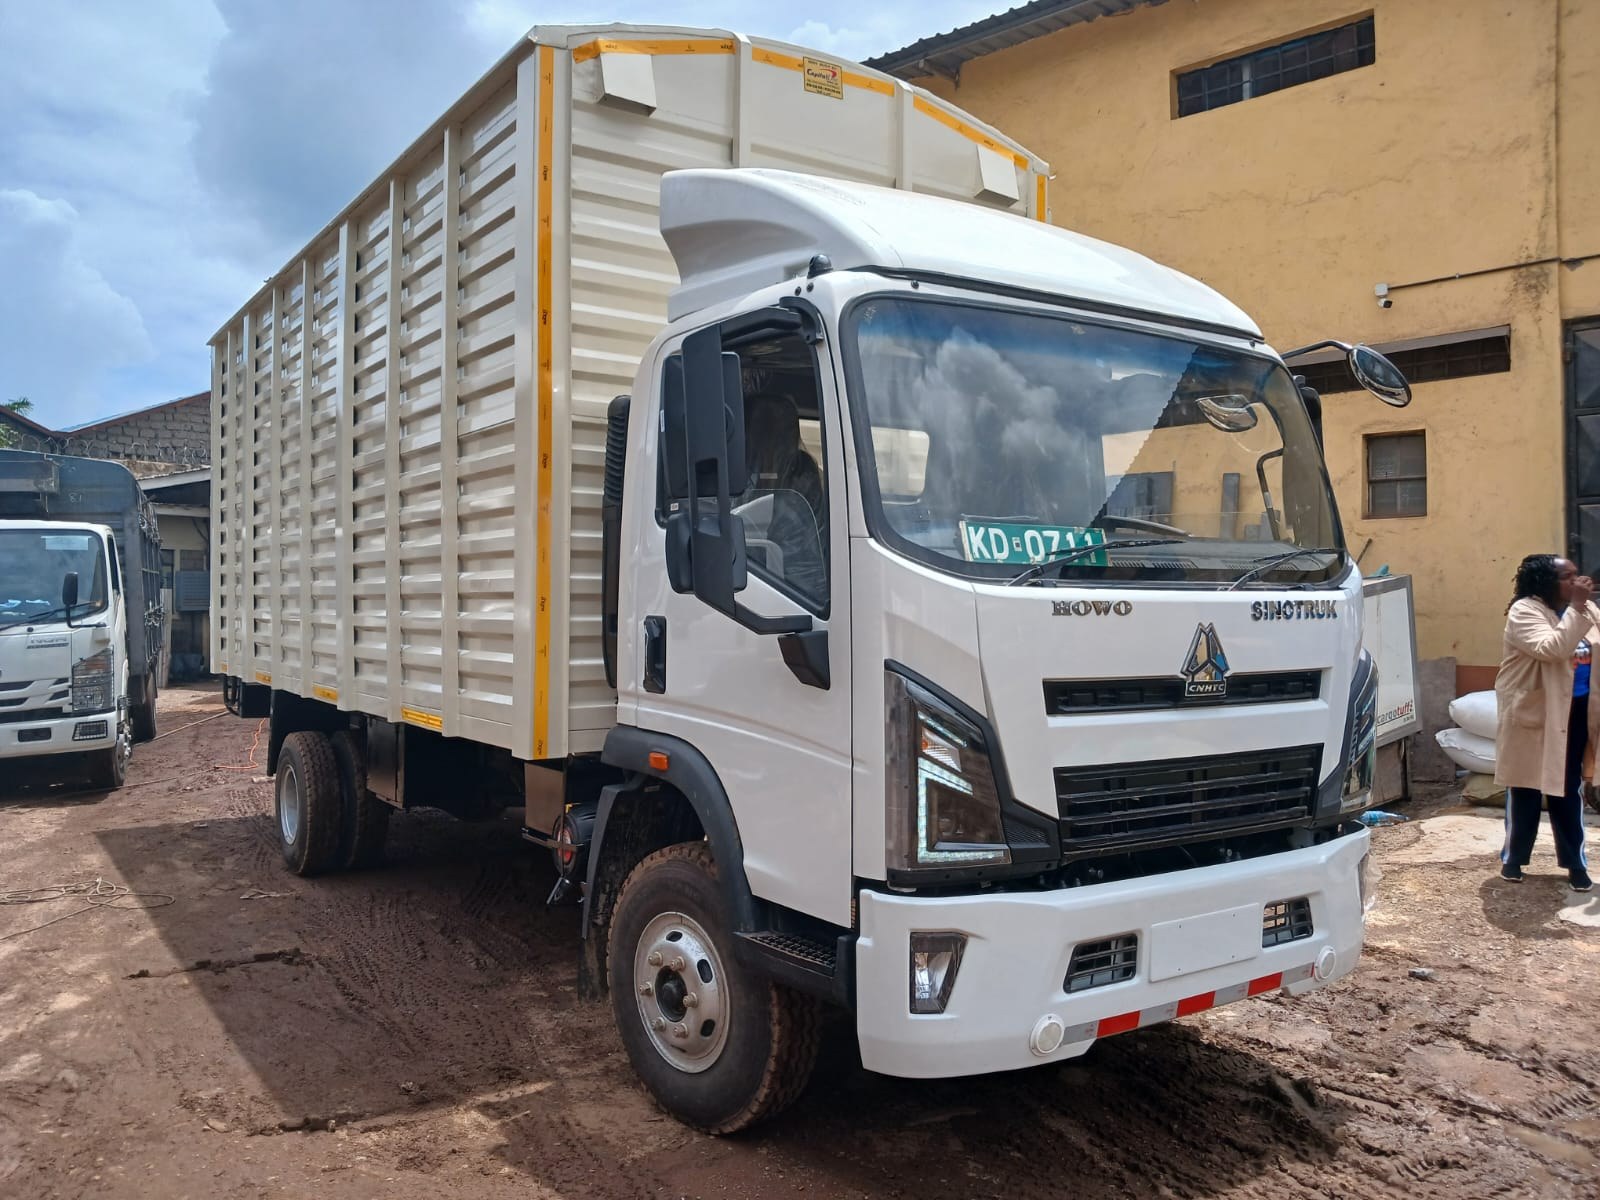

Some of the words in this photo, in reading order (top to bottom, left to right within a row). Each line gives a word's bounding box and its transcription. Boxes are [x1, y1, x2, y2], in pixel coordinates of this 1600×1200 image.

[968, 527, 1009, 560] KD
[1052, 600, 1133, 616] HOWO
[1251, 600, 1338, 621] SINOTRUK
[1188, 683, 1225, 692] CNHTC
